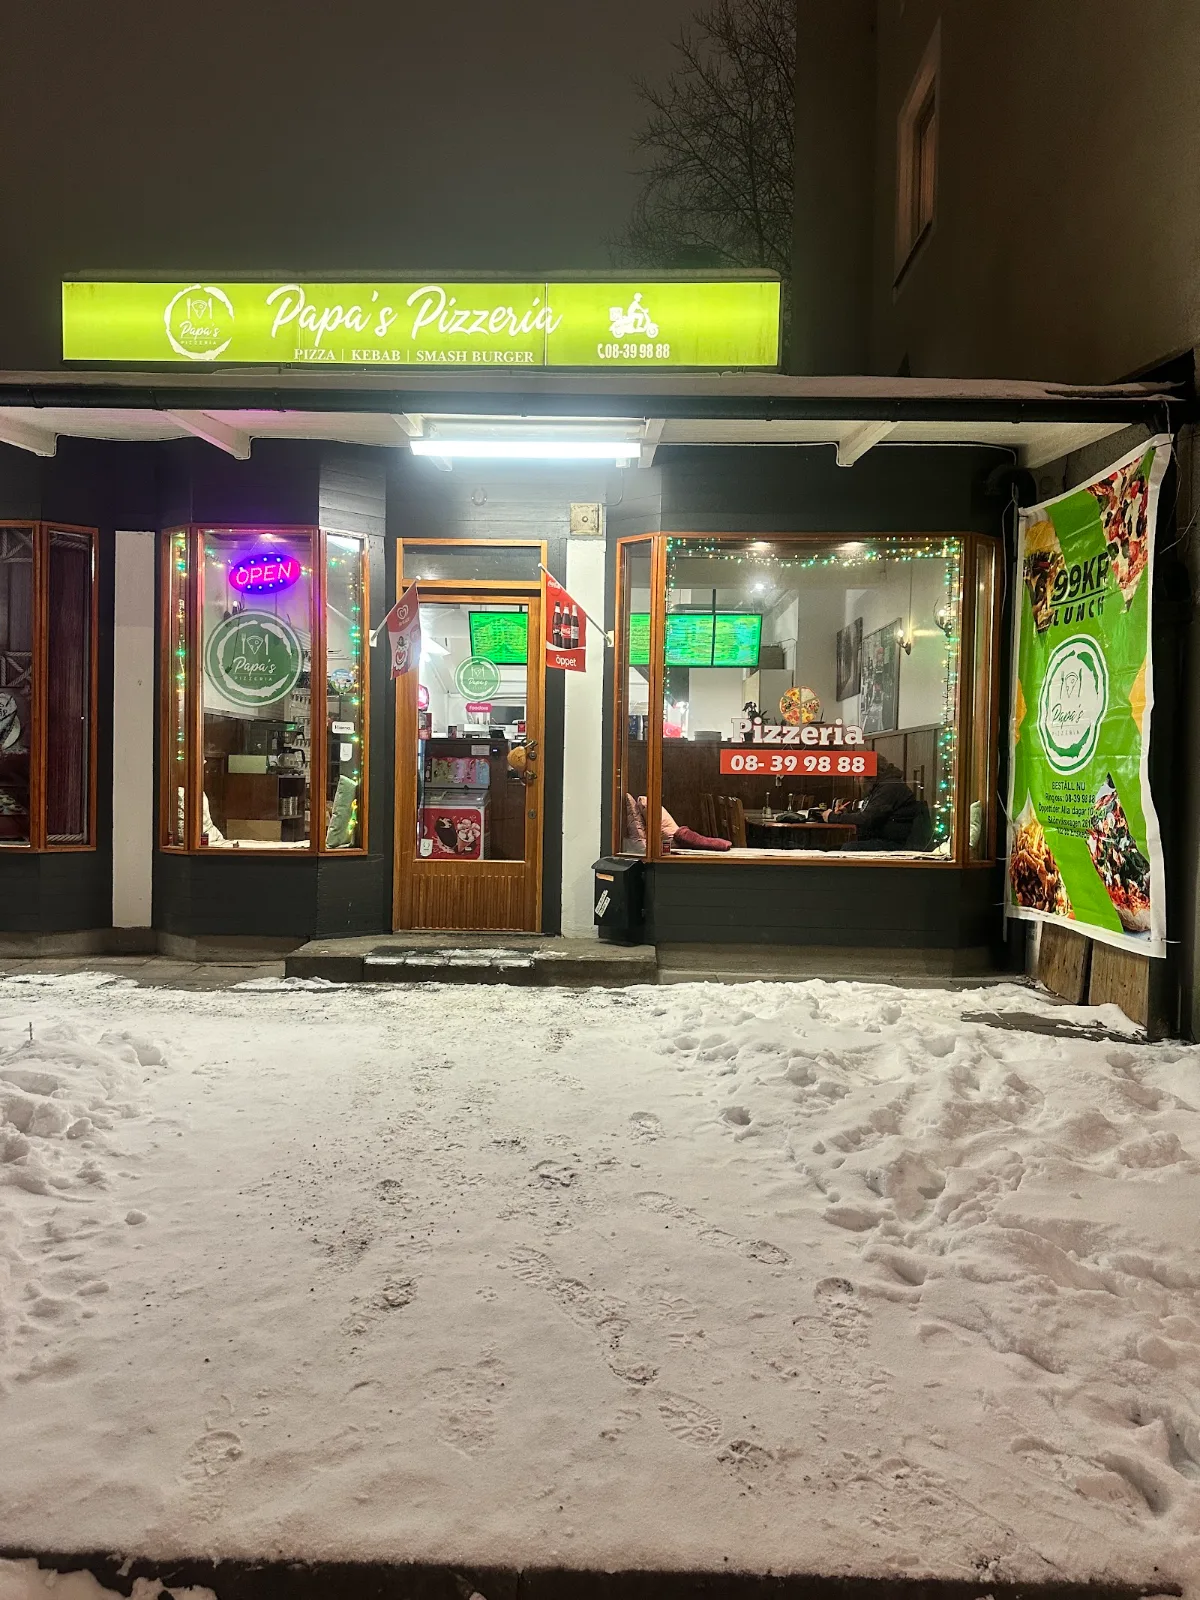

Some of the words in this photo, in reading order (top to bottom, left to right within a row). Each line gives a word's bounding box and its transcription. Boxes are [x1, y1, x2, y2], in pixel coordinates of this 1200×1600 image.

[266, 283, 398, 347] Papa's
[406, 285, 563, 340] Pizzeria
[180, 320, 220, 340] Papa's
[294, 348, 336, 360] PIZZA
[351, 349, 401, 361] KEBAB
[416, 350, 468, 362] SMASH
[472, 350, 535, 363] BURGER
[605, 343, 637, 359] 08-39
[639, 343, 654, 359] 98
[655, 343, 670, 359] 88
[236, 561, 292, 585] OPEN
[1053, 596, 1105, 626] LUNCH
[233, 656, 277, 676] Papa's
[555, 654, 577, 667] öppet
[1052, 703, 1084, 729] Papa's
[731, 716, 865, 746] Pizzeria
[730, 755, 765, 771] 08-
[770, 755, 798, 772] 39
[803, 755, 831, 772] 98
[837, 756, 865, 773] 88
[1052, 780, 1075, 791] BESTÄLL
[1076, 782, 1086, 791] NU
